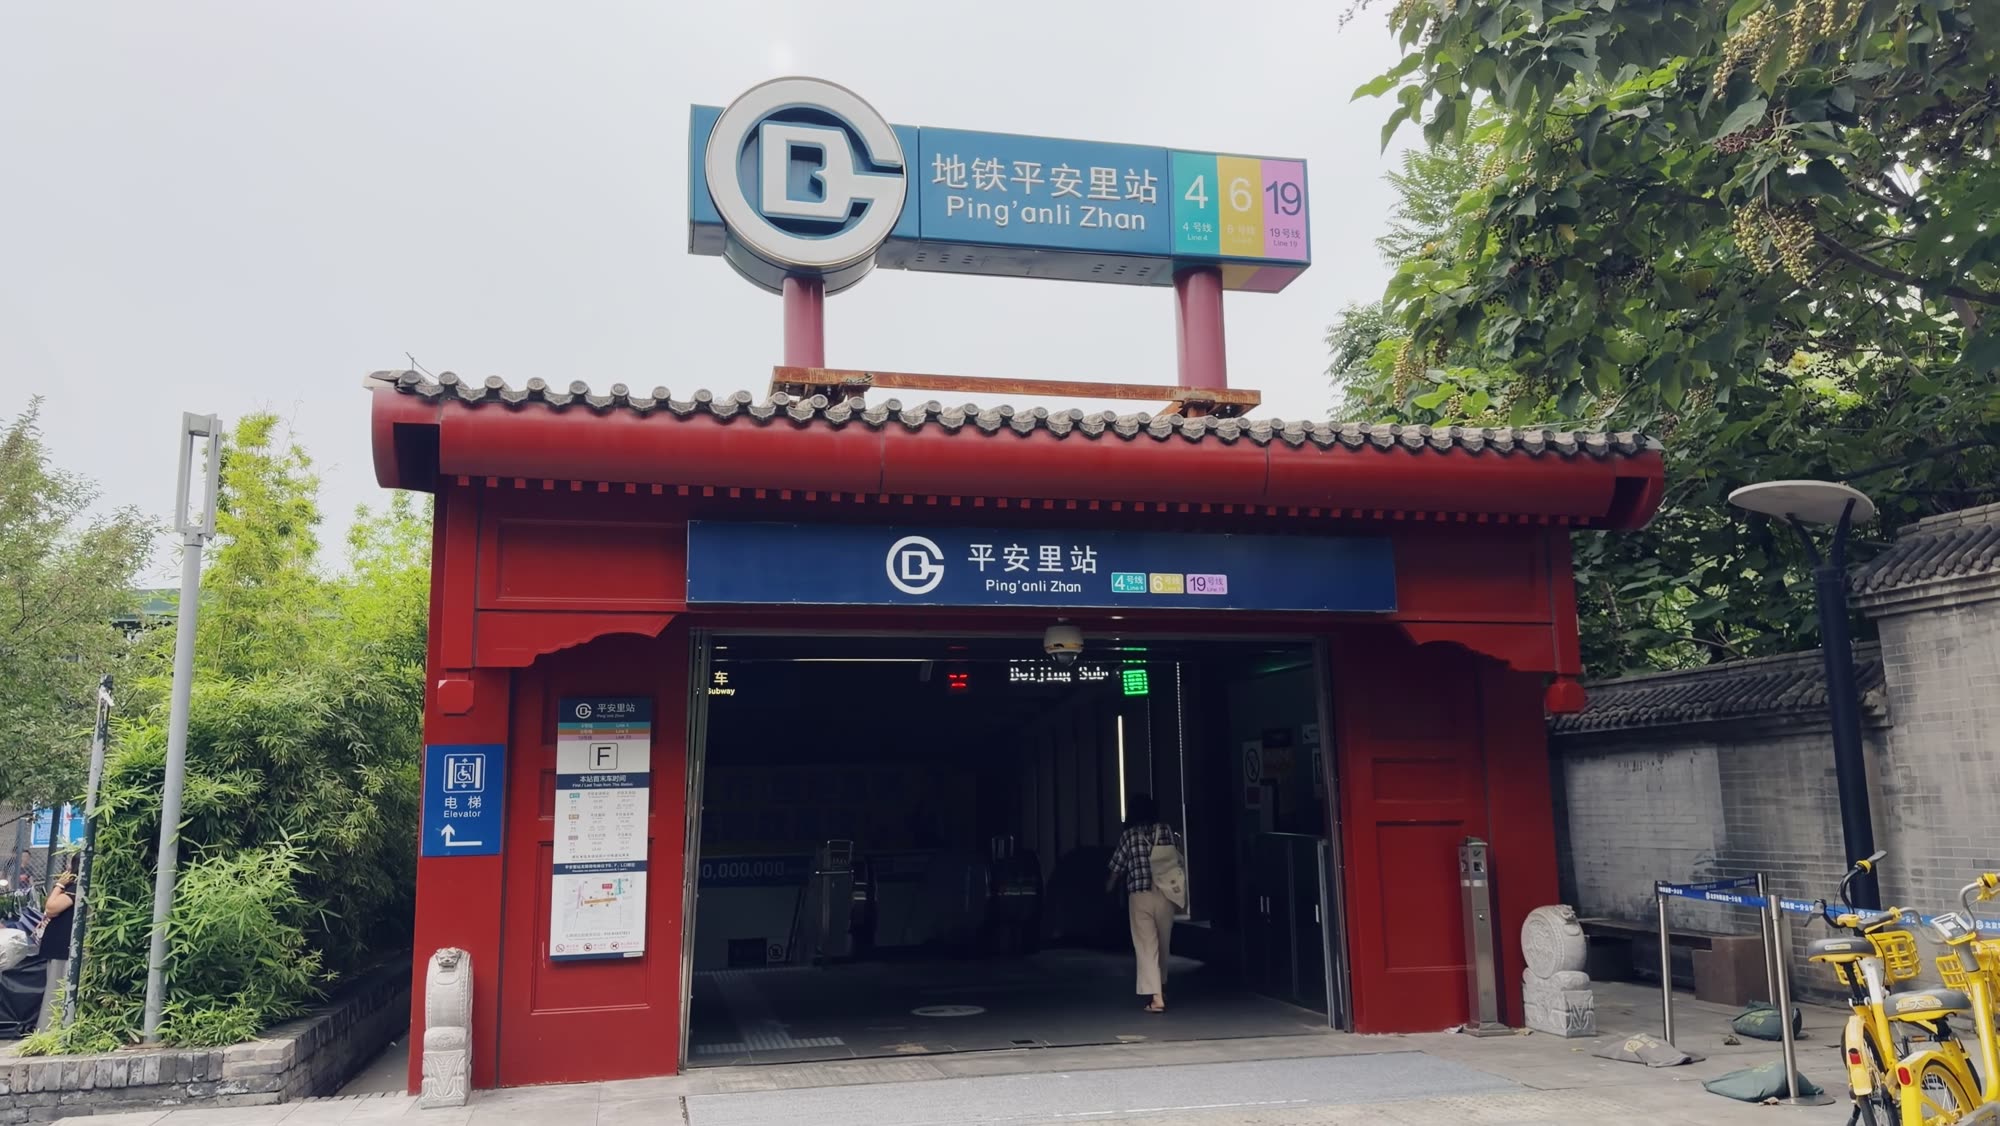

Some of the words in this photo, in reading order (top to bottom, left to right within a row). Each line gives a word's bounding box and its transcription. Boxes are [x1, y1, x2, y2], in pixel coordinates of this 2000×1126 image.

[931, 152, 1158, 205] 地铁平安里站
[1184, 174, 1209, 209] 4
[1230, 176, 1253, 212] 6
[947, 195, 1071, 226] Ping'anli
[1079, 205, 1146, 230] Zhan
[1265, 180, 1302, 216] 19
[967, 543, 1098, 574] 平安里站
[985, 579, 1047, 594] Ping'anli
[1049, 580, 1082, 593] Zhan
[1190, 576, 1206, 592] 19
[597, 702, 636, 713] 平安里站
[597, 746, 612, 767] F
[443, 810, 482, 819] Elevator
